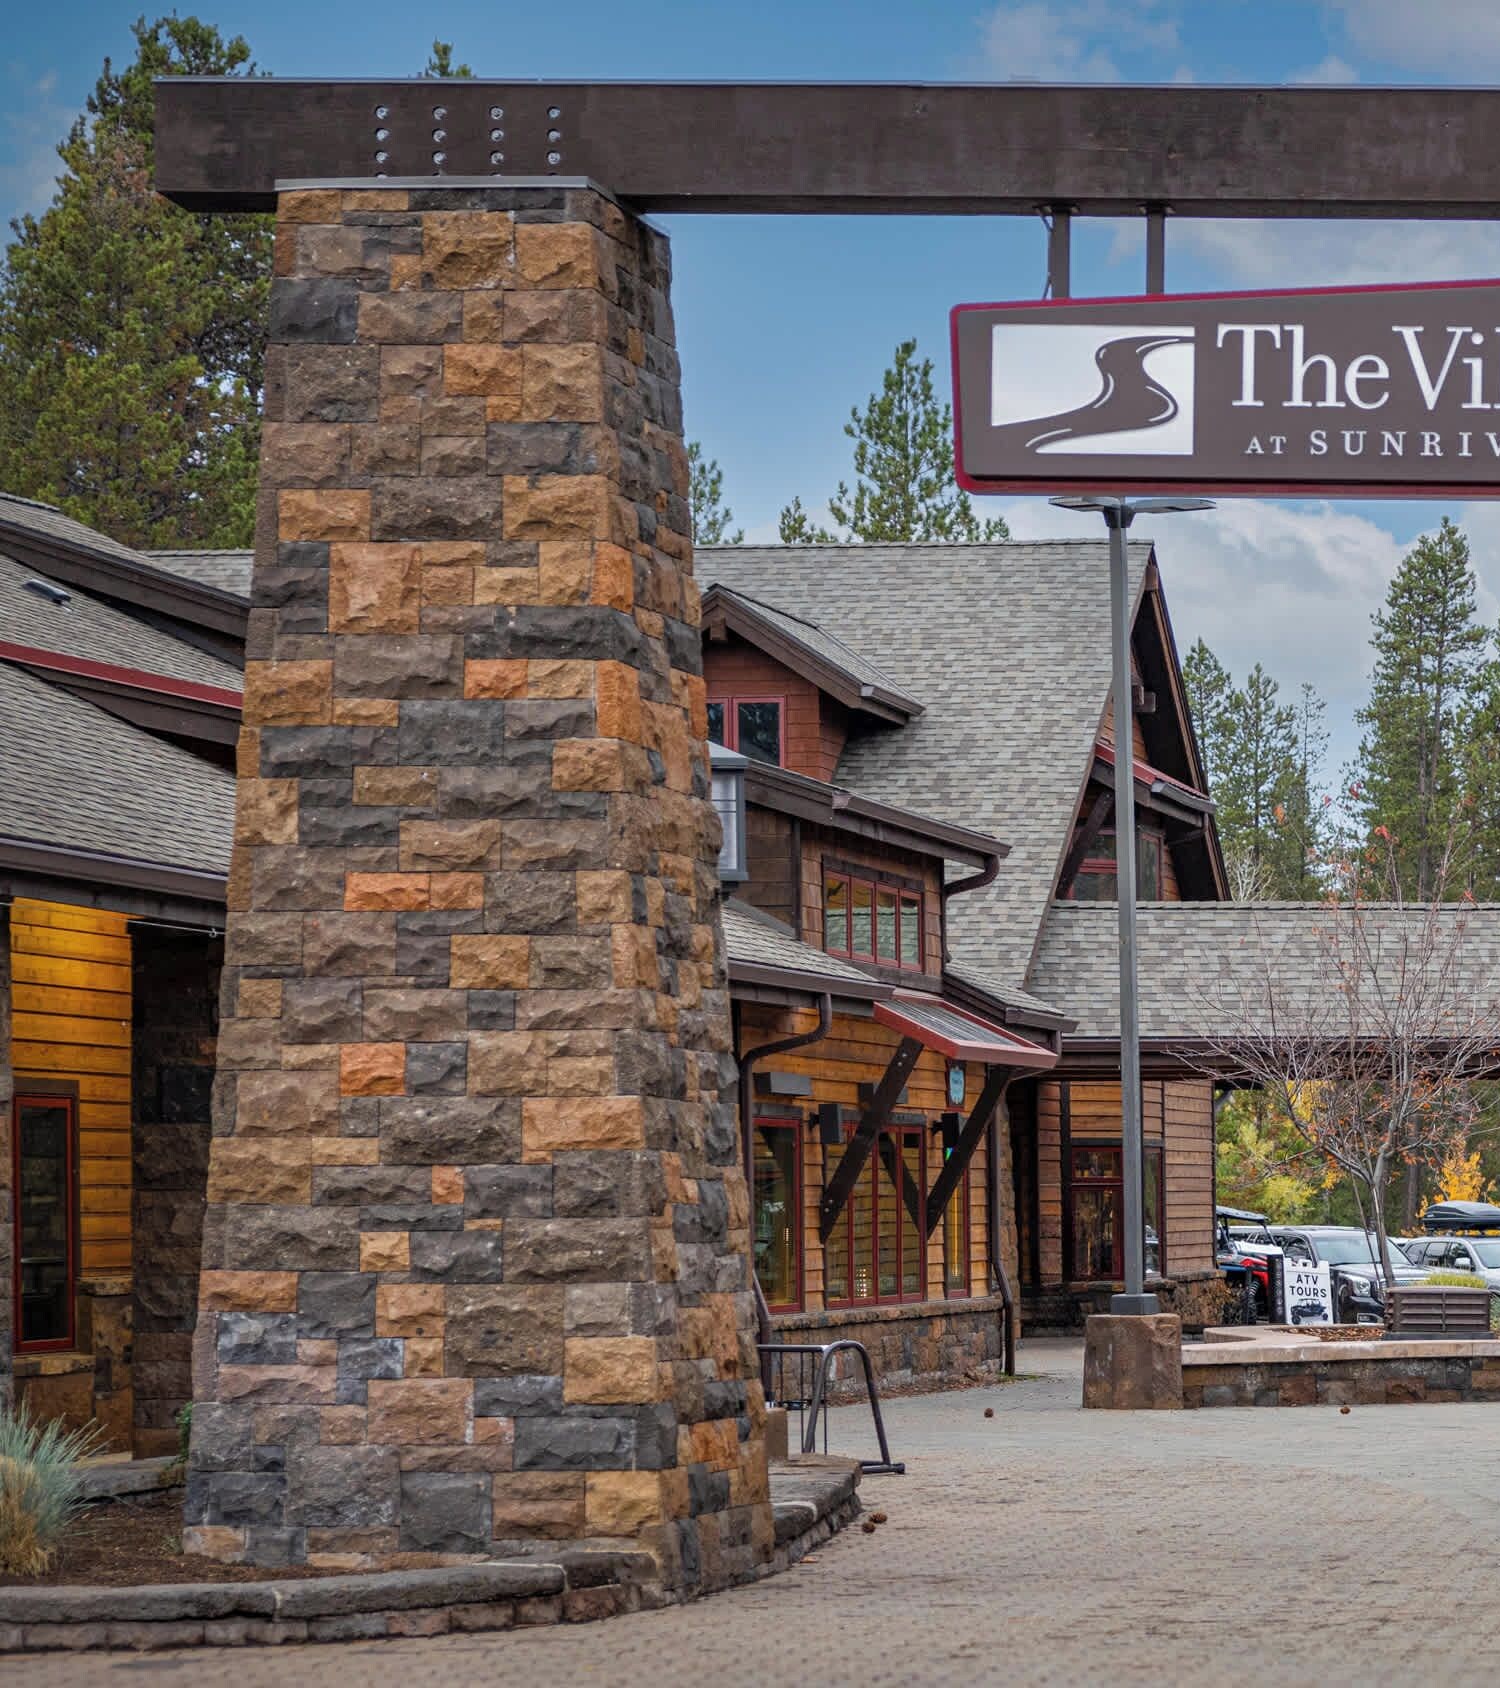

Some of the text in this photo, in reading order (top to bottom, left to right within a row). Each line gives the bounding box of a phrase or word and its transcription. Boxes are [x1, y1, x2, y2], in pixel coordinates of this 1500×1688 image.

[1216, 323, 1390, 411] The
[1245, 436, 1287, 455] AT
[1296, 1274, 1319, 1285] ATV
[1289, 1286, 1327, 1298] TOURS
